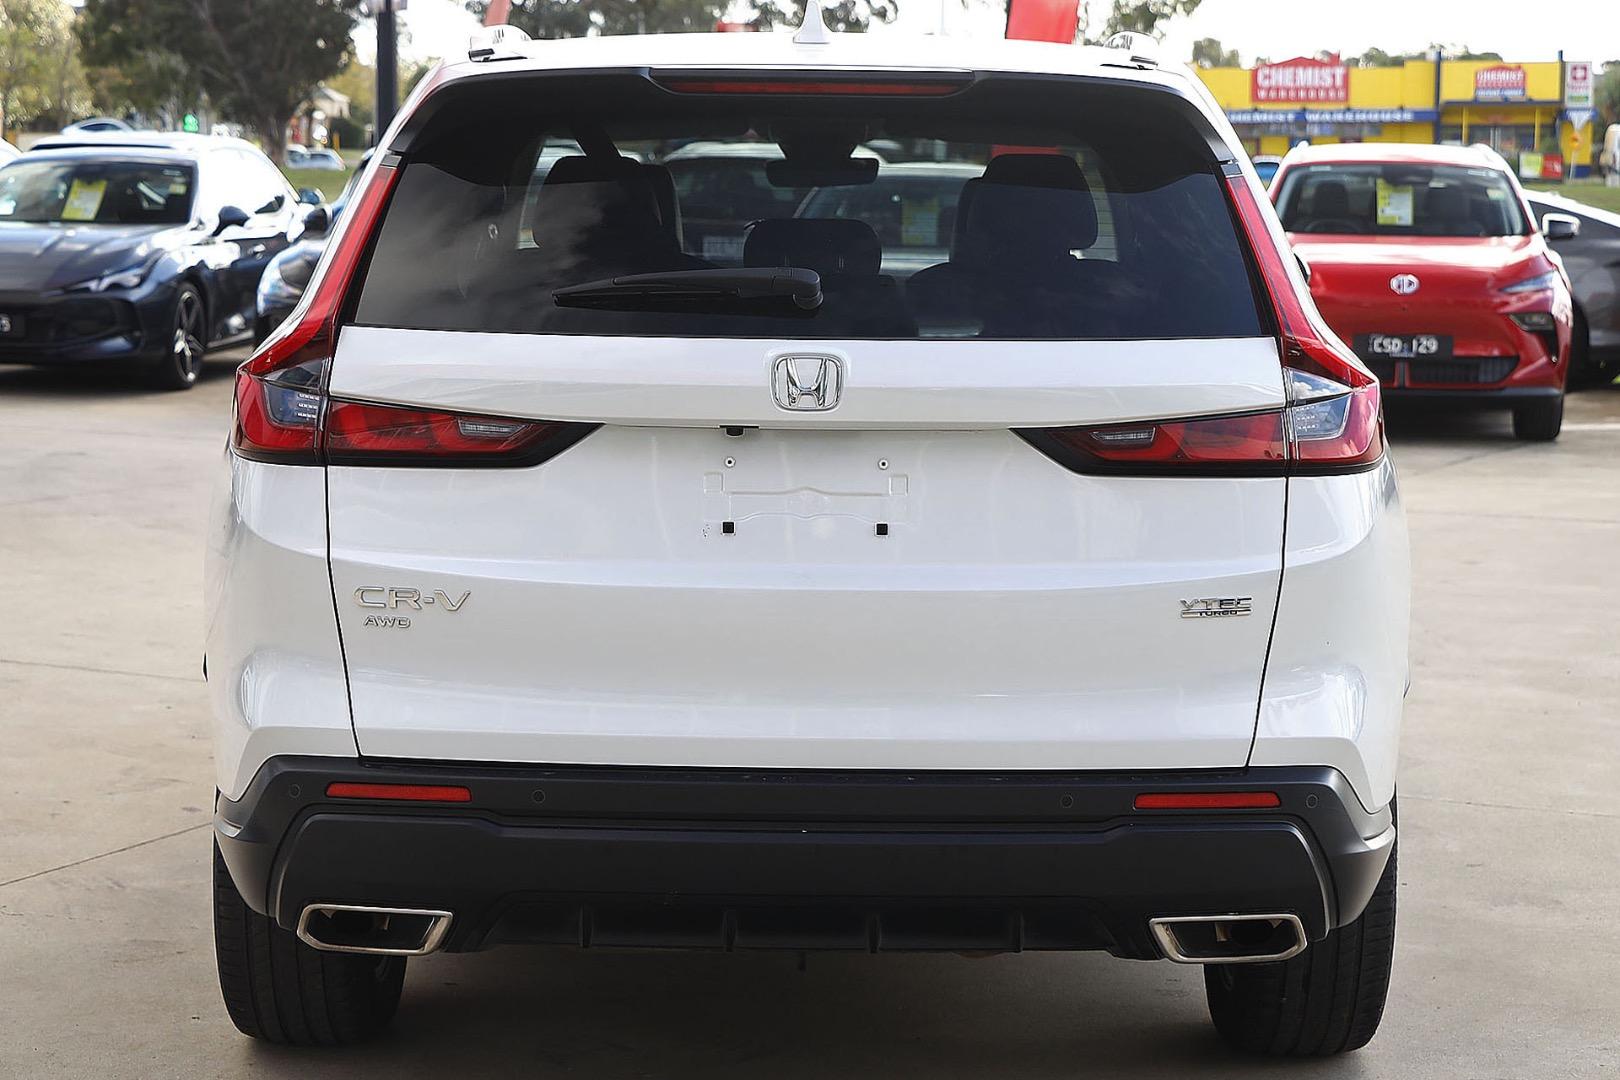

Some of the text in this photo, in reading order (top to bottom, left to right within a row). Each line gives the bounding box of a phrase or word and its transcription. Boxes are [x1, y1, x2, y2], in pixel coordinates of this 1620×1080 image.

[1256, 66, 1345, 88] CHEMIST
[1305, 110, 1414, 122] WAREHOUSE
[353, 586, 471, 611] CR-V
[364, 615, 411, 628] AWD
